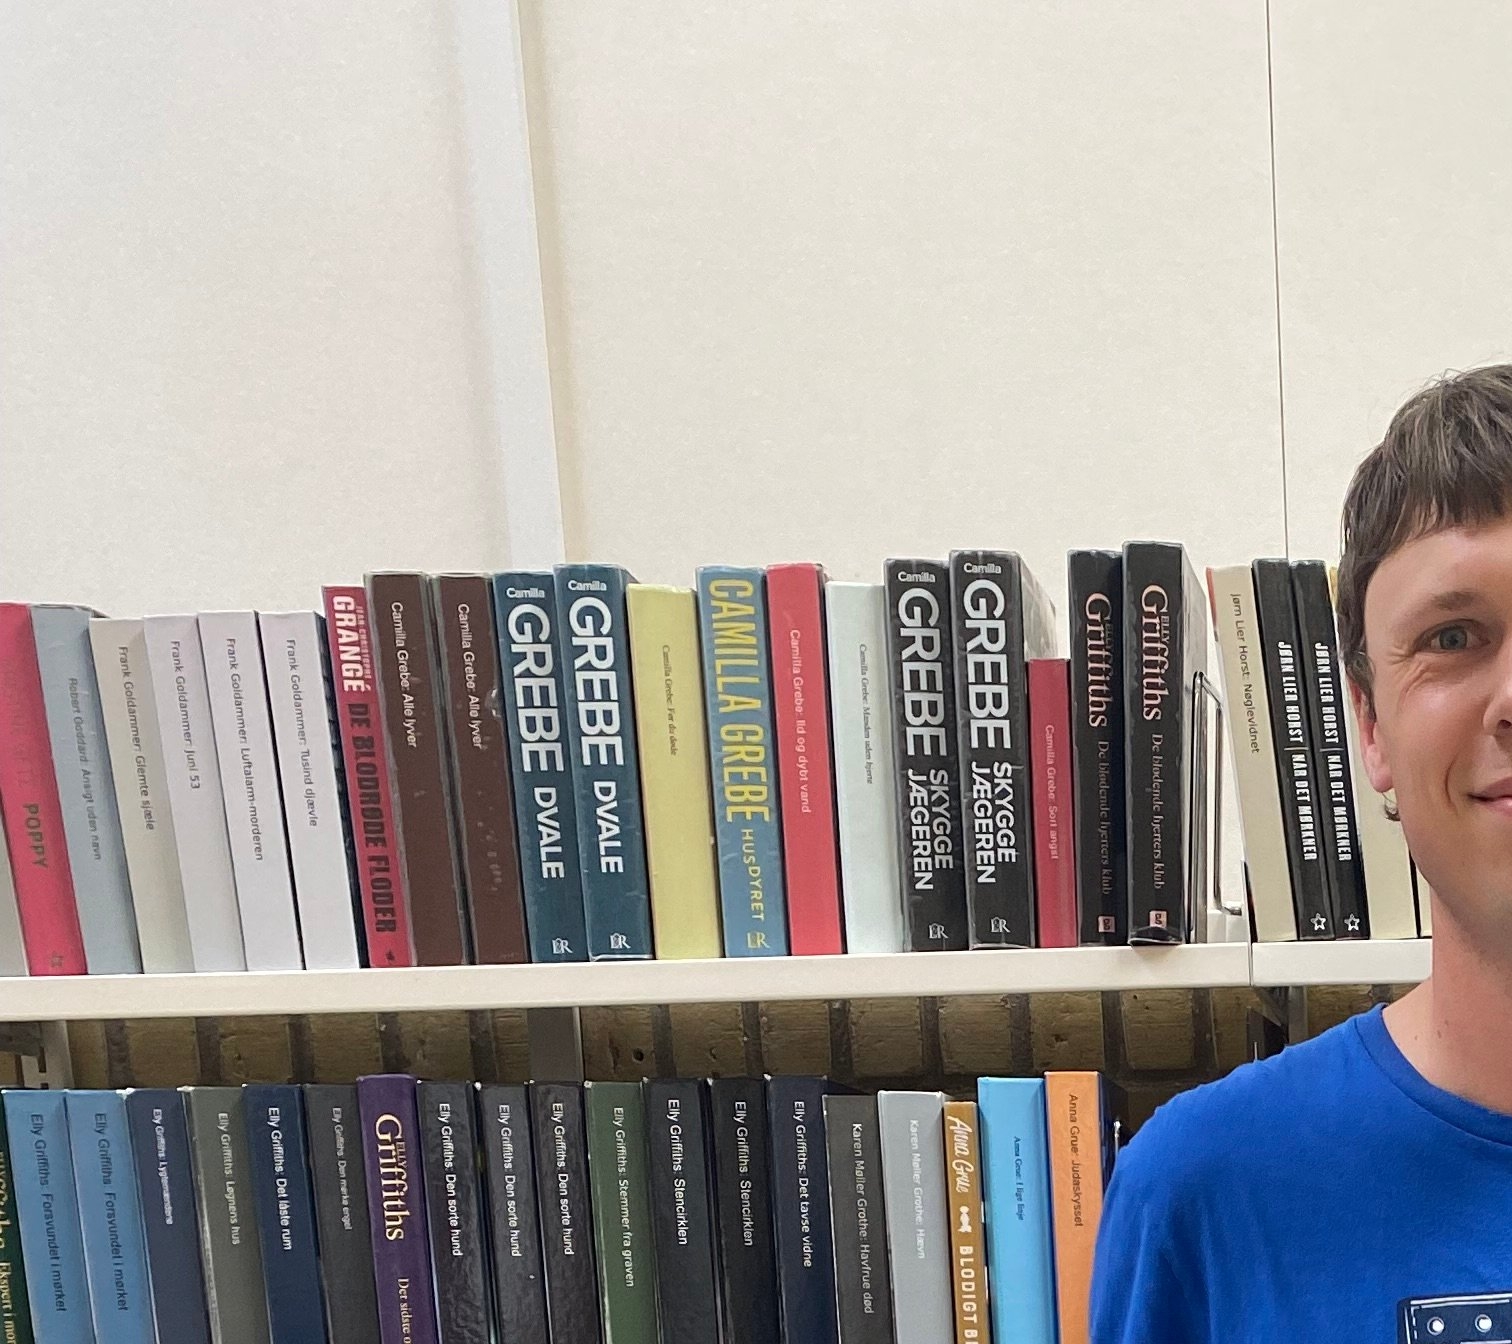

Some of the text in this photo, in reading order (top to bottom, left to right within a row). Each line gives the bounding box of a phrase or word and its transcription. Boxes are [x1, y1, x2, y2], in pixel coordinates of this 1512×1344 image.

[567, 580, 607, 591] Camilla
[963, 563, 1002, 574] Camilla
[1314, 643, 1330, 672] JØRN
[1317, 677, 1334, 702] LIER
[569, 596, 623, 873] GREBE DVALE
[963, 579, 1016, 863] GREBE SKYGGE
[1321, 707, 1338, 743] HORST
[332, 595, 396, 932] GRANGÉ DE BLODRØDE FLODER
[709, 579, 770, 921] CAMILLA GREBE HUSDYRET
[1331, 782, 1345, 802] DET
[971, 761, 995, 883] JÆGEREN
[1332, 806, 1351, 861] MØRKNER
[613, 1107, 624, 1126] Elly
[948, 1116, 972, 1157] Anna
[373, 1114, 411, 1241] Griffiths
[953, 1160, 973, 1193] Grue
[619, 1180, 631, 1229] Stemmer
[623, 1232, 633, 1246] fra
[621, 1250, 635, 1286] graven
[960, 1246, 977, 1322] BLODIGT
[398, 1279, 409, 1297] Det
[400, 1302, 413, 1333] sidste
